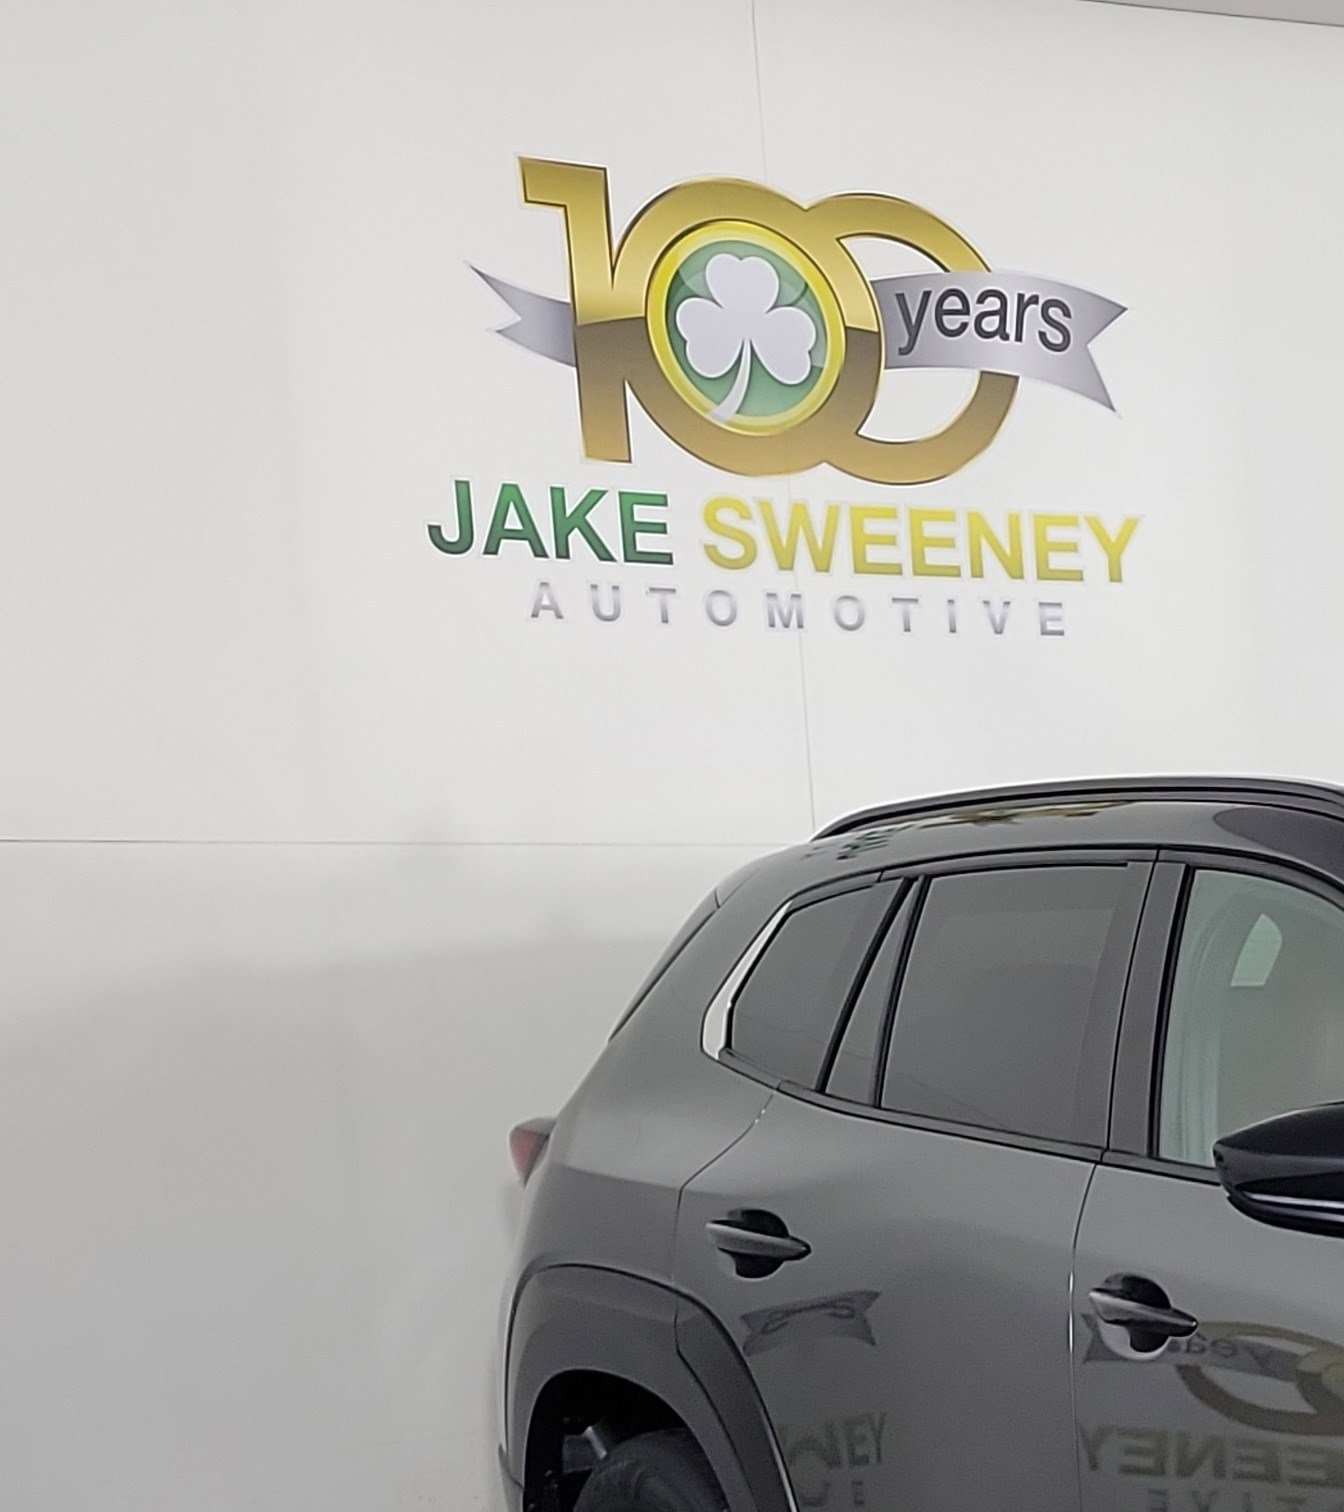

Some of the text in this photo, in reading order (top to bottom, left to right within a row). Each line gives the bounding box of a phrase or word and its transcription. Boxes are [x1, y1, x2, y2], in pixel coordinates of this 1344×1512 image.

[516, 154, 1074, 485] 100 years
[427, 479, 1143, 583] JAKE SWEENEY
[530, 581, 1065, 637] AUTOMOTIVE
